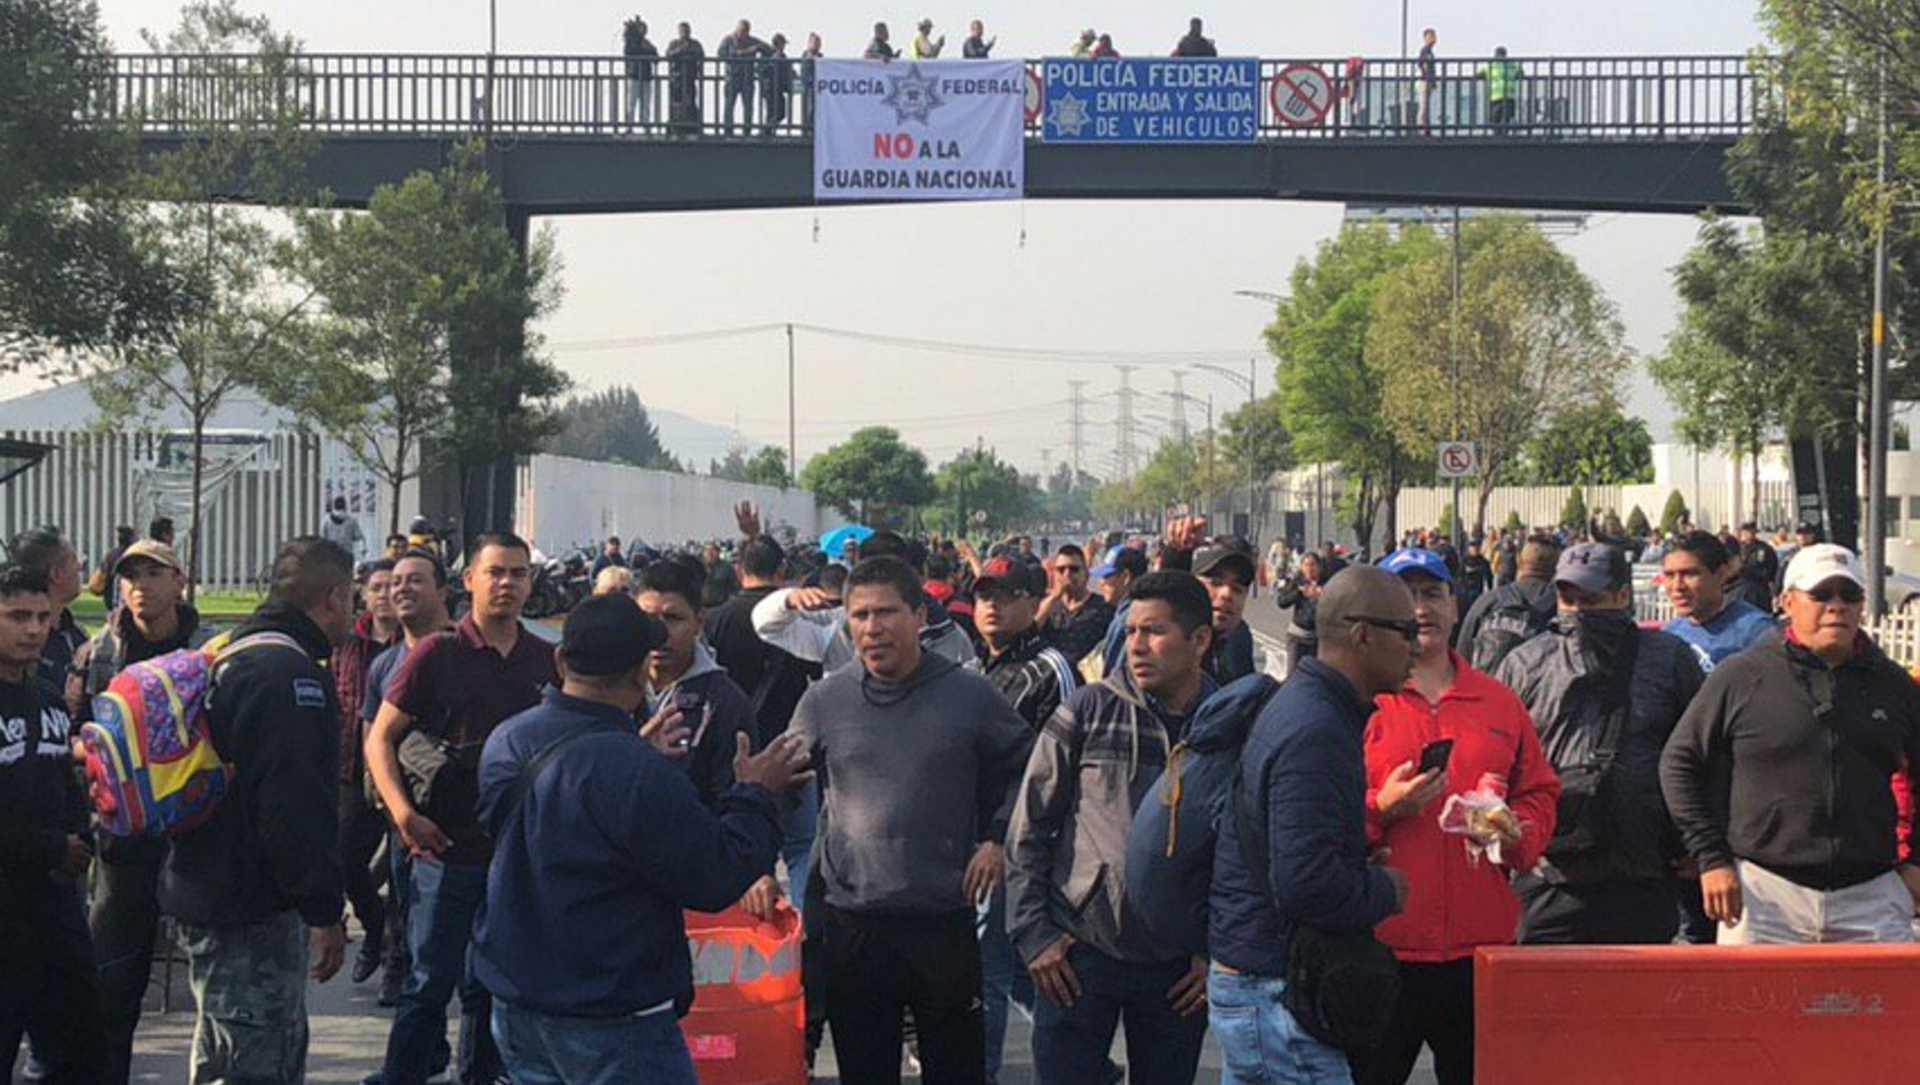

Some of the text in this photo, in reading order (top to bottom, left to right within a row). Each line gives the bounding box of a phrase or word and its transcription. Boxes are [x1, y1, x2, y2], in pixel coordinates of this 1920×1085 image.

[1047, 61, 1254, 87] POLICÍA FEDERAL
[817, 79, 1022, 95] POLICÍA FEDERAL
[1096, 92, 1254, 112] ENTRADA Y SALIDA
[1096, 116, 1255, 137] DE VEHICULOS
[873, 132, 961, 160] NO A LA
[822, 168, 1017, 189] GUARDIA NACIONAL
